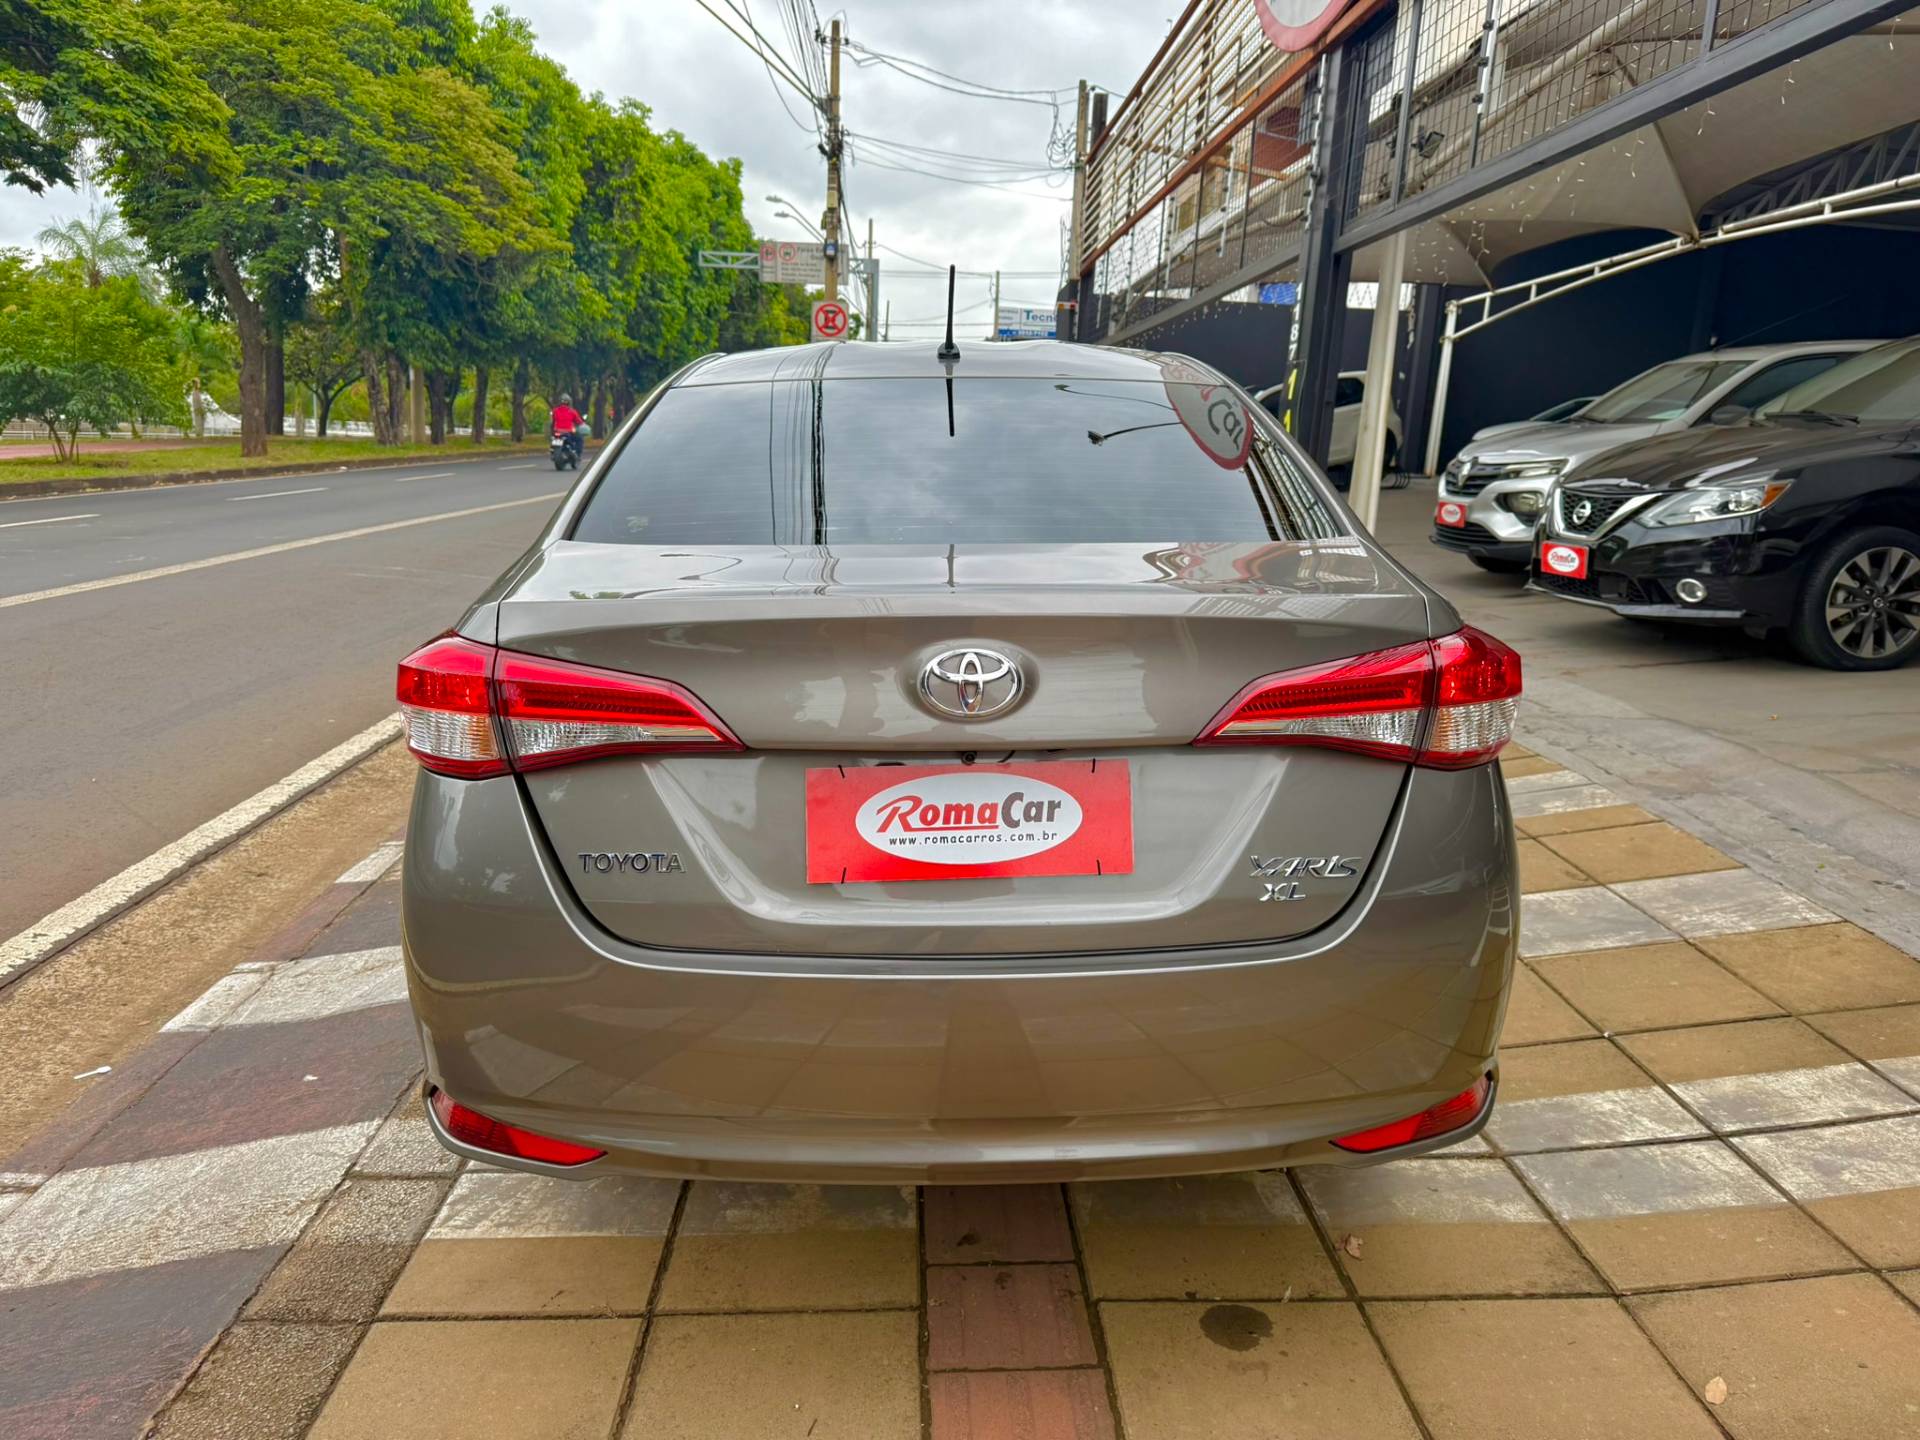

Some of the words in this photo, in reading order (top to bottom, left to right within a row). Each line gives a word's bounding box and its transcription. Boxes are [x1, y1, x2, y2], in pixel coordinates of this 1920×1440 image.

[889, 830, 1058, 846] www.romacarros.com.br
[577, 852, 687, 874] TOYOTA
[1250, 855, 1363, 878] YARIS
[1259, 881, 1306, 902] XL
